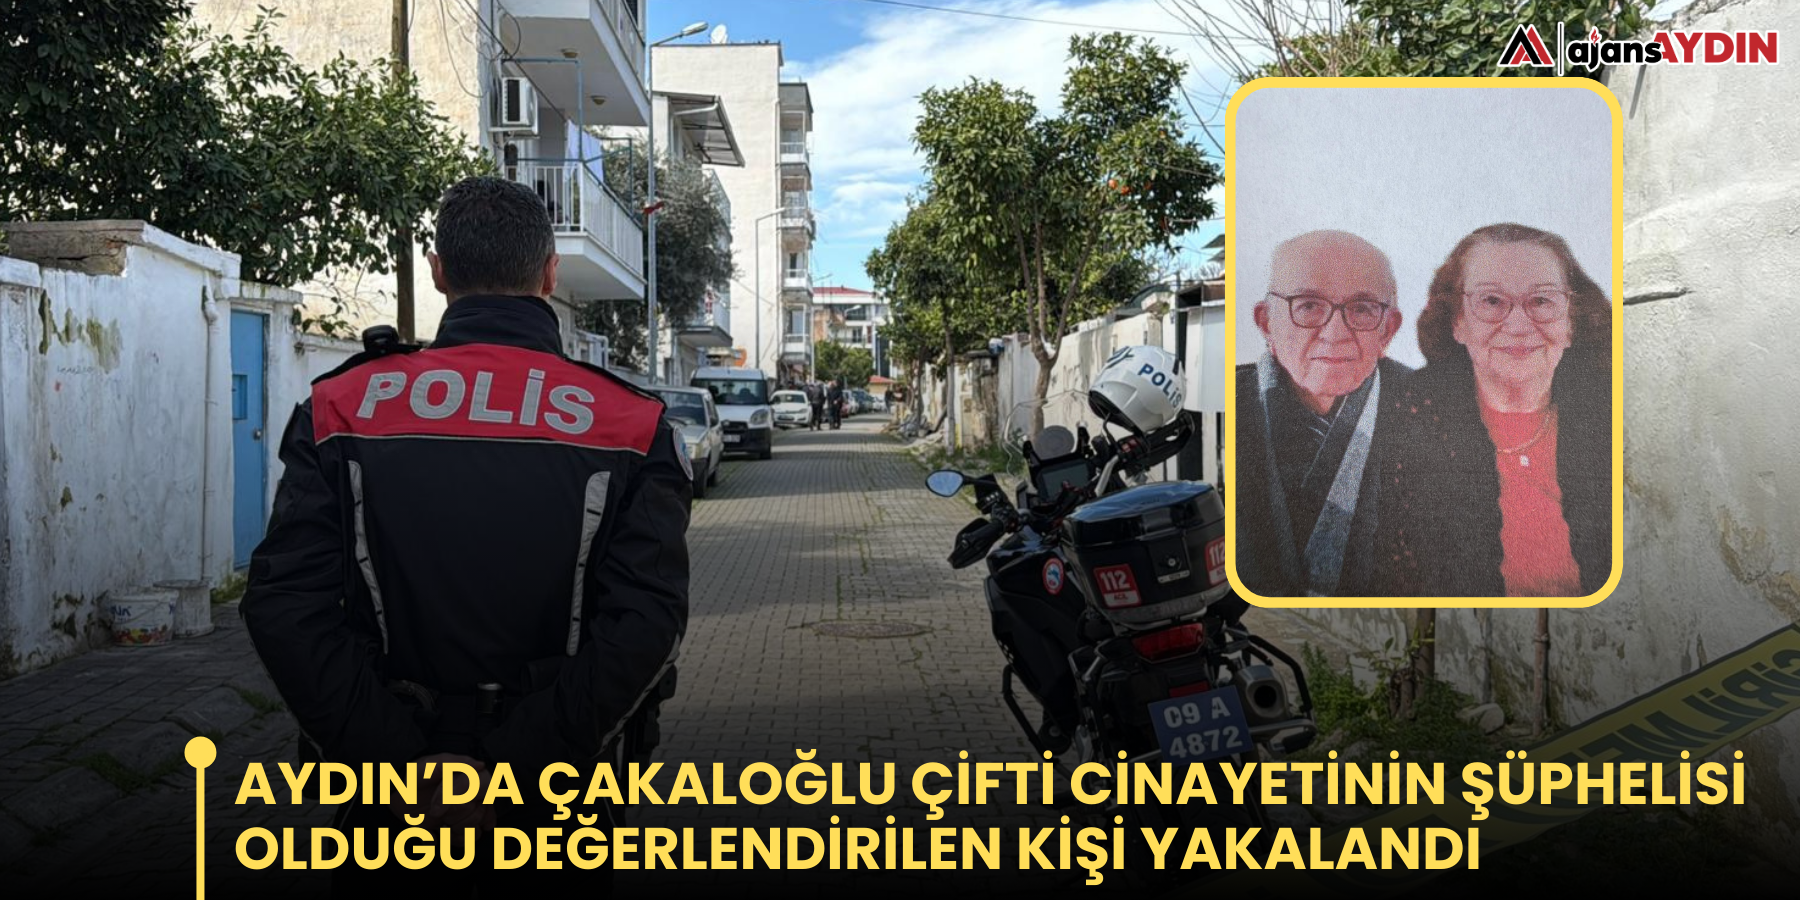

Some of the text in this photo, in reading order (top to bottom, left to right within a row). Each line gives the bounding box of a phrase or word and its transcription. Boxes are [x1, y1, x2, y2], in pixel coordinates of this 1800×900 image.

[356, 368, 595, 434] POLİS
[1137, 363, 1182, 408] POLİS
[1100, 570, 1131, 590] 112
[1163, 696, 1231, 728] 09 A
[1169, 725, 1243, 759] 4872
